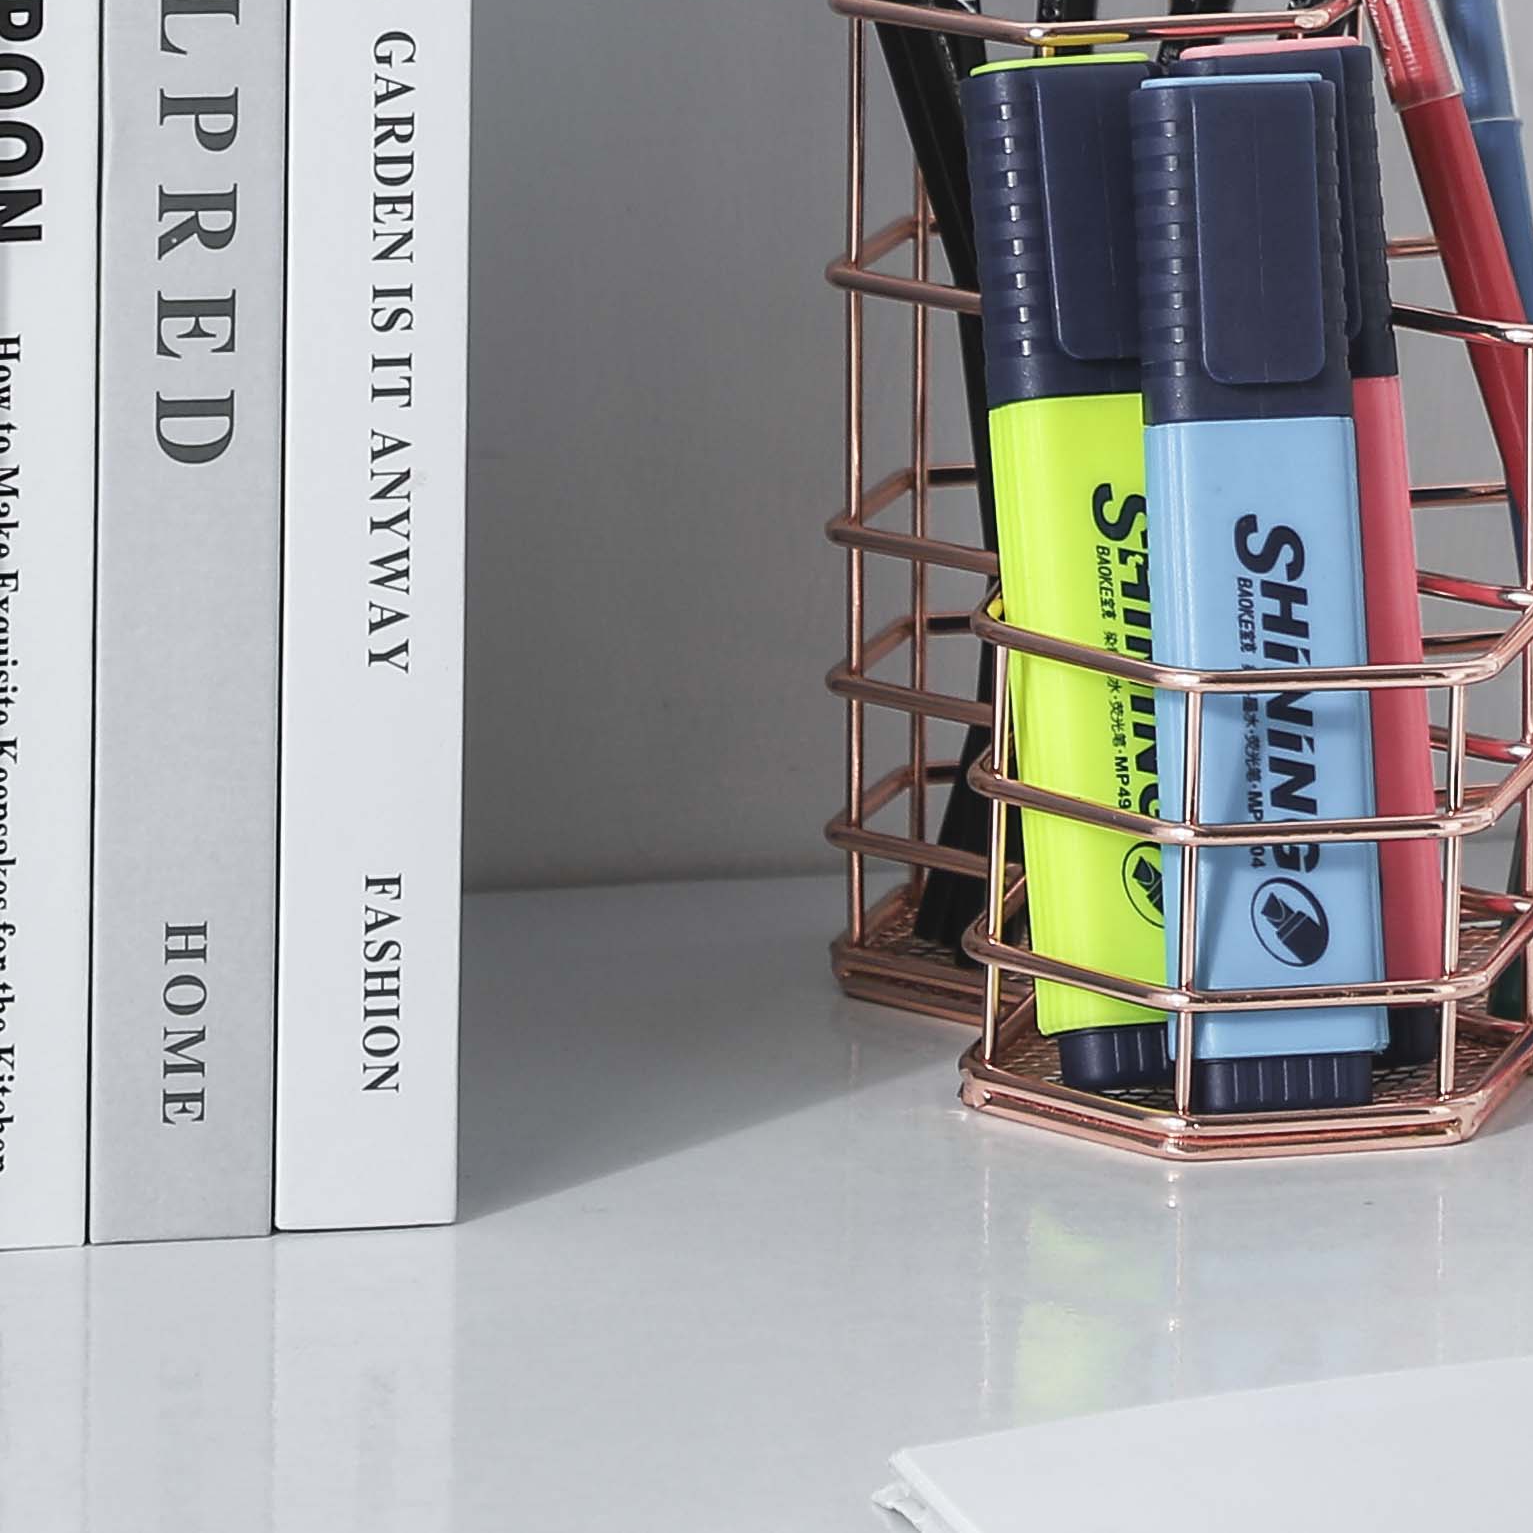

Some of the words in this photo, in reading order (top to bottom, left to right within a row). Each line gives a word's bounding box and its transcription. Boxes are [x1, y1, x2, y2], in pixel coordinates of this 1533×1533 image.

[373, 32, 416, 262] GARDEN
[371, 284, 413, 332] IS
[371, 354, 412, 407] IT
[368, 430, 411, 673] ANYWAY
[162, 920, 208, 1124] HOME
[362, 874, 402, 1092] FASHION
